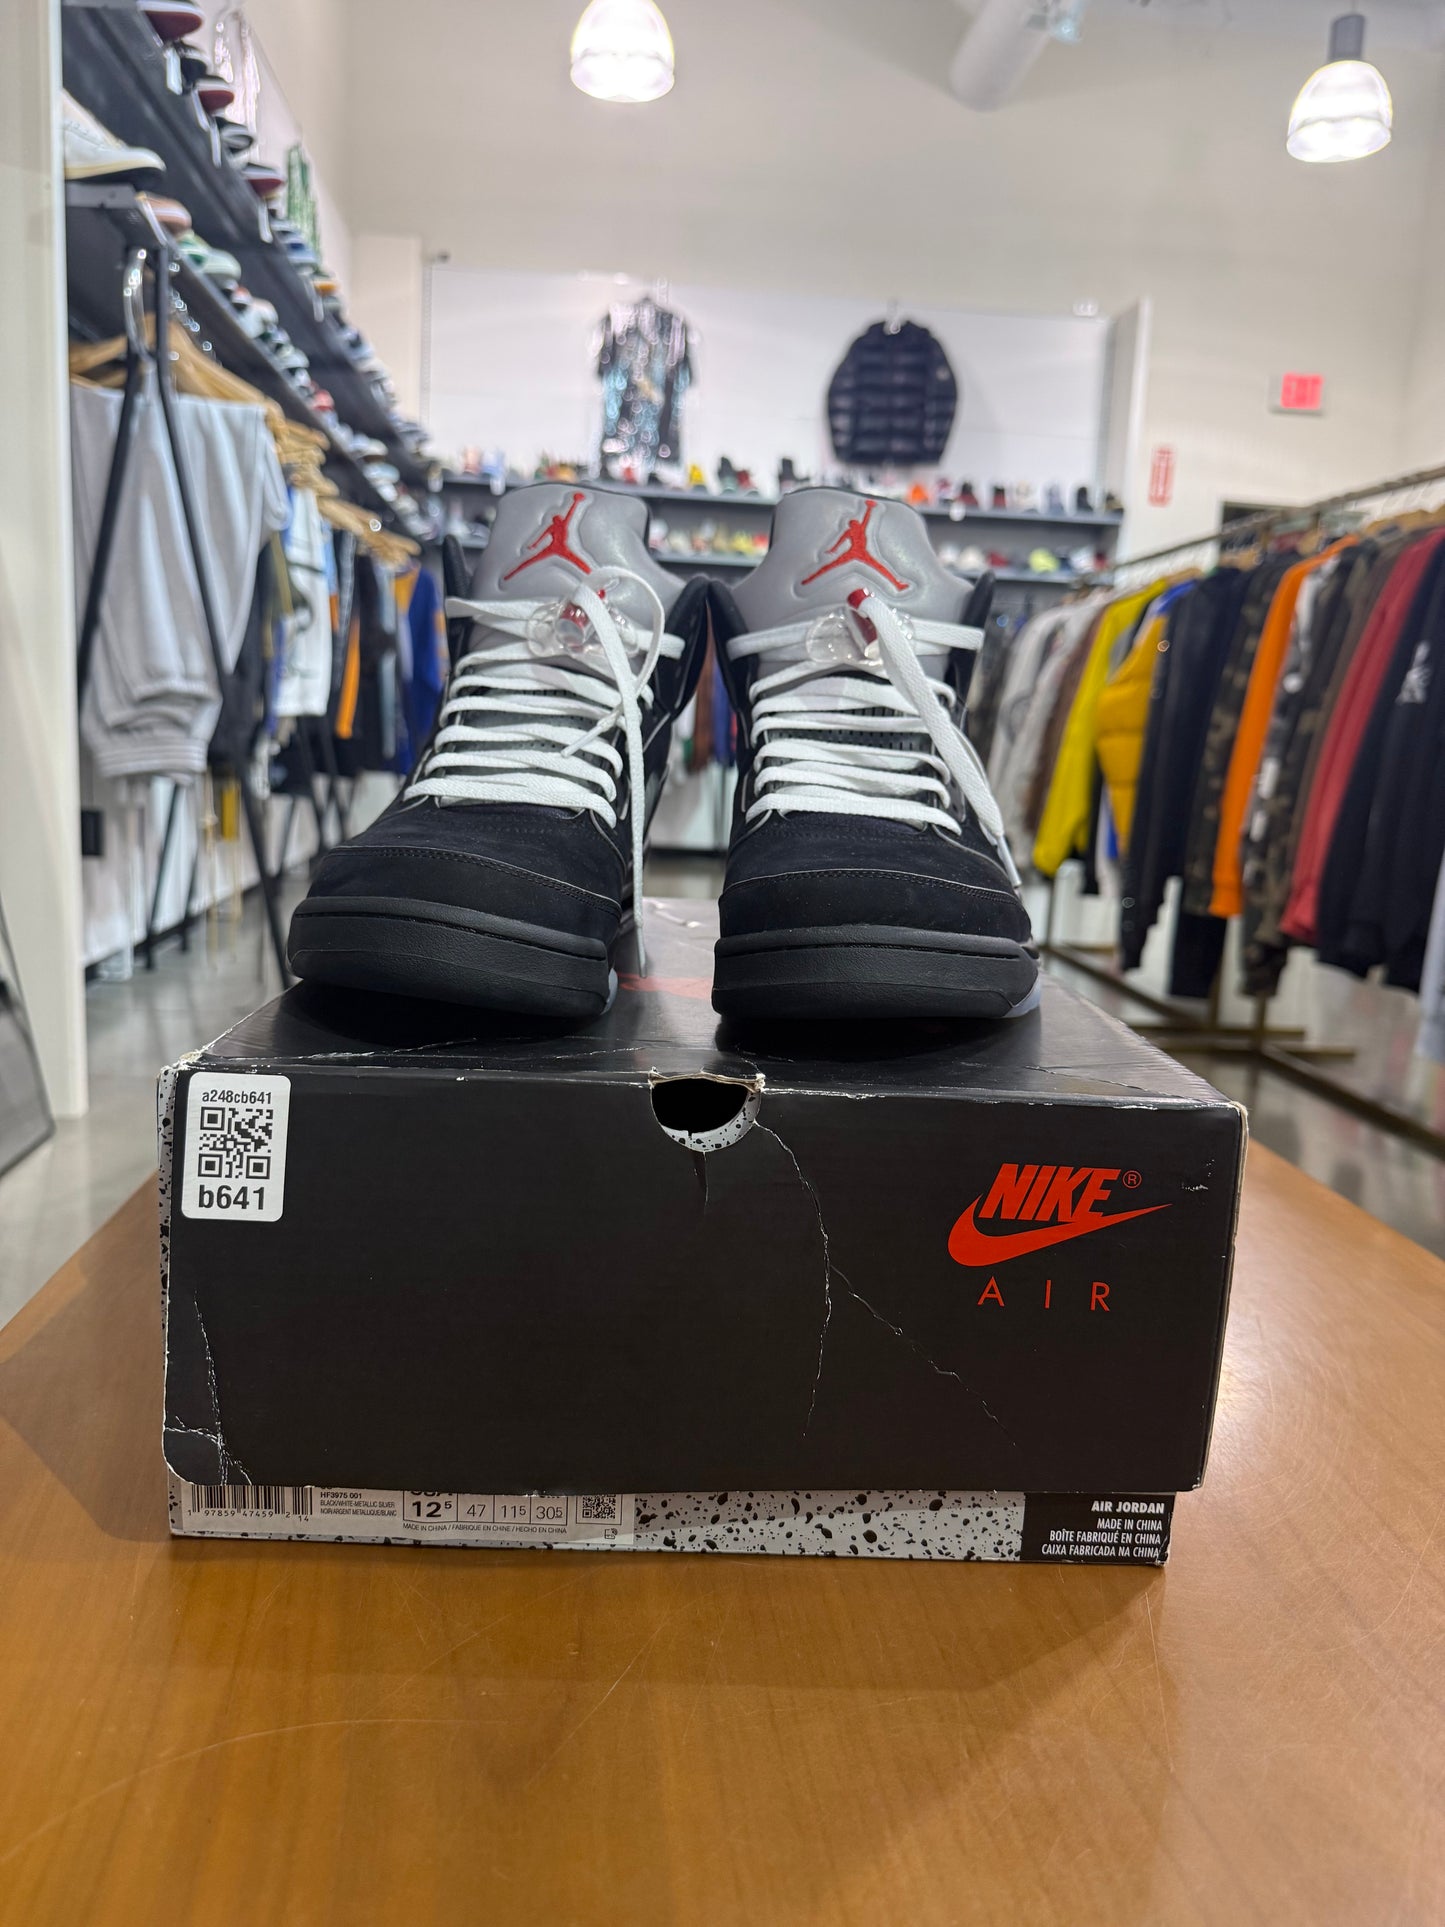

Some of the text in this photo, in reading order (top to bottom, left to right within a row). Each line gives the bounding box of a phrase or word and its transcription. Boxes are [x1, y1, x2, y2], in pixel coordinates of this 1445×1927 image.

[202, 1090, 272, 1104] a248cb641
[198, 1184, 264, 1210] b641
[978, 1163, 1121, 1223] NIKE
[466, 1504, 486, 1517] 47
[1091, 1501, 1164, 1514] AIR JORDAN
[1097, 1518, 1162, 1531] MADE IN CHINA
[1049, 1529, 1160, 1545] BOÎTE FABRIQUÉ EN CHINA
[1041, 1544, 1159, 1558] CAIXA FABRICADA NA CHINA
